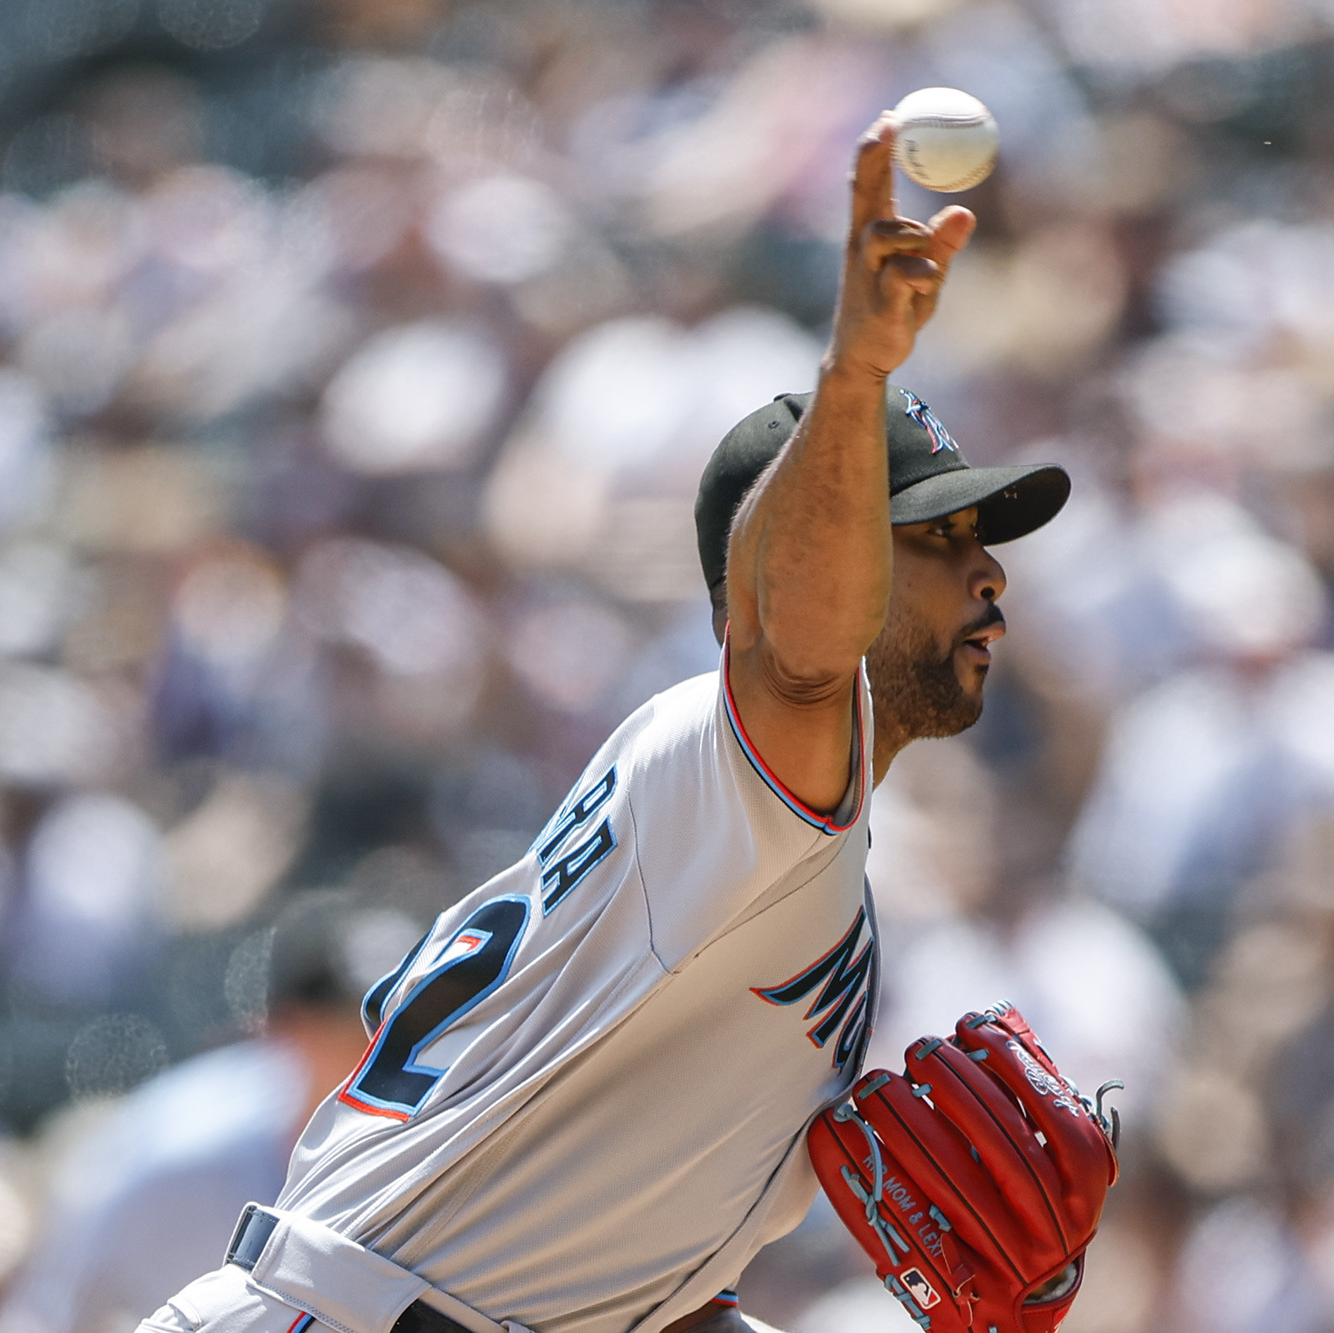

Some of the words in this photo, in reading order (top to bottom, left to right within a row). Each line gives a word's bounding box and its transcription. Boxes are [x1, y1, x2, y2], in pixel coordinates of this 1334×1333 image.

[528, 758, 619, 919] RA
[882, 1176, 917, 1212] MOM
[909, 1211, 924, 1225] &
[917, 1223, 944, 1258] LEXI
